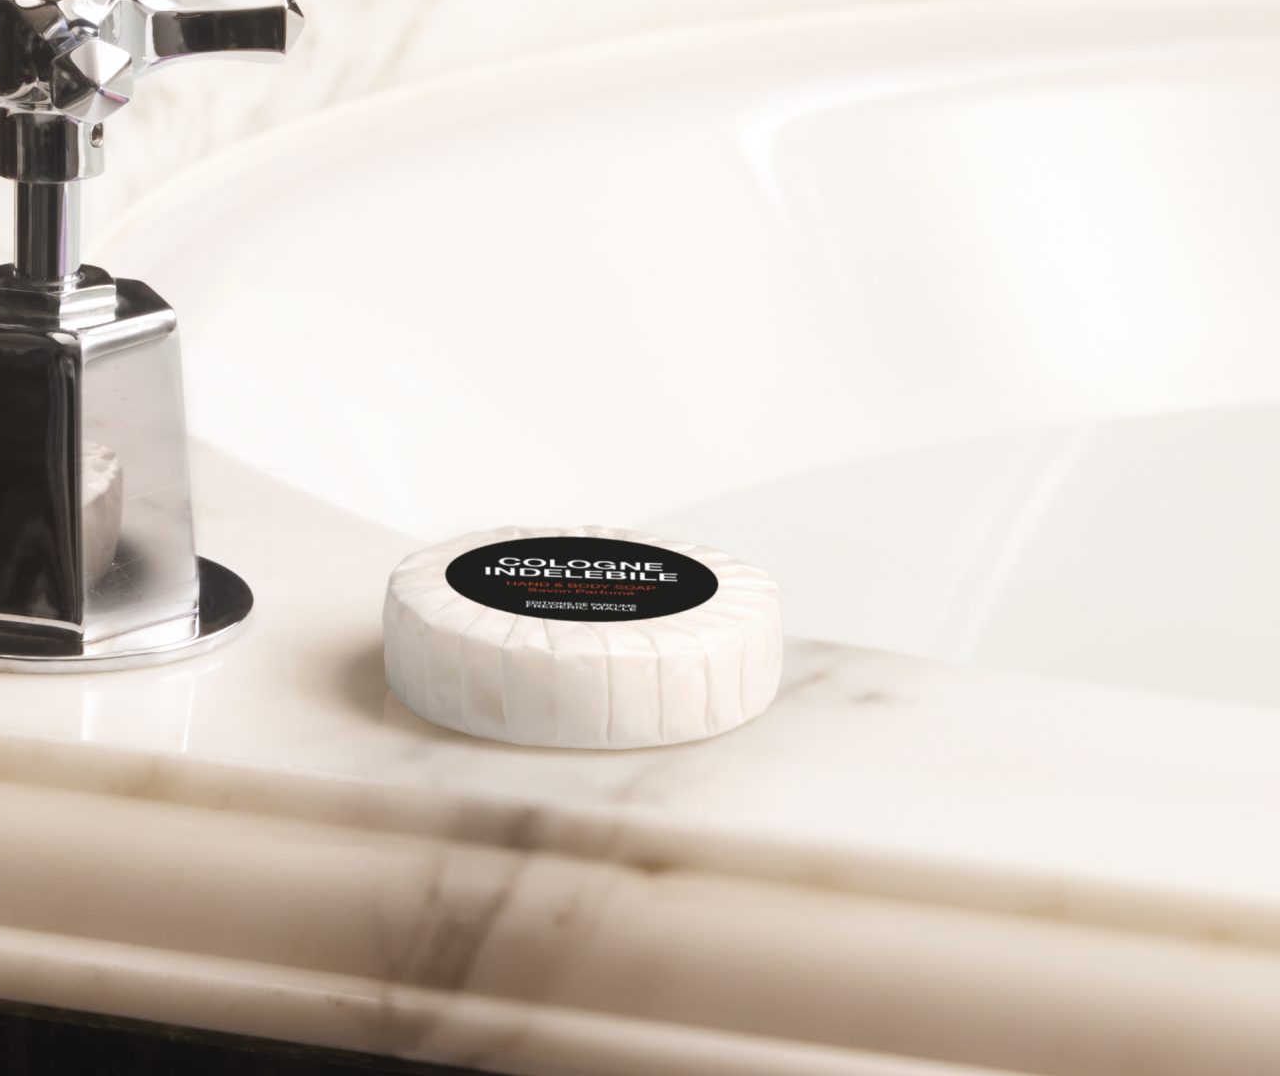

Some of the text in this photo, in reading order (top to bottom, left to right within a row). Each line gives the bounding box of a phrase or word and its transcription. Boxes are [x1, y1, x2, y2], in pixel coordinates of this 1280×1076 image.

[498, 556, 664, 572] COLOGNE
[484, 566, 679, 582] INDELEBILE
[506, 580, 549, 588] HAND
[567, 582, 610, 590] BODY
